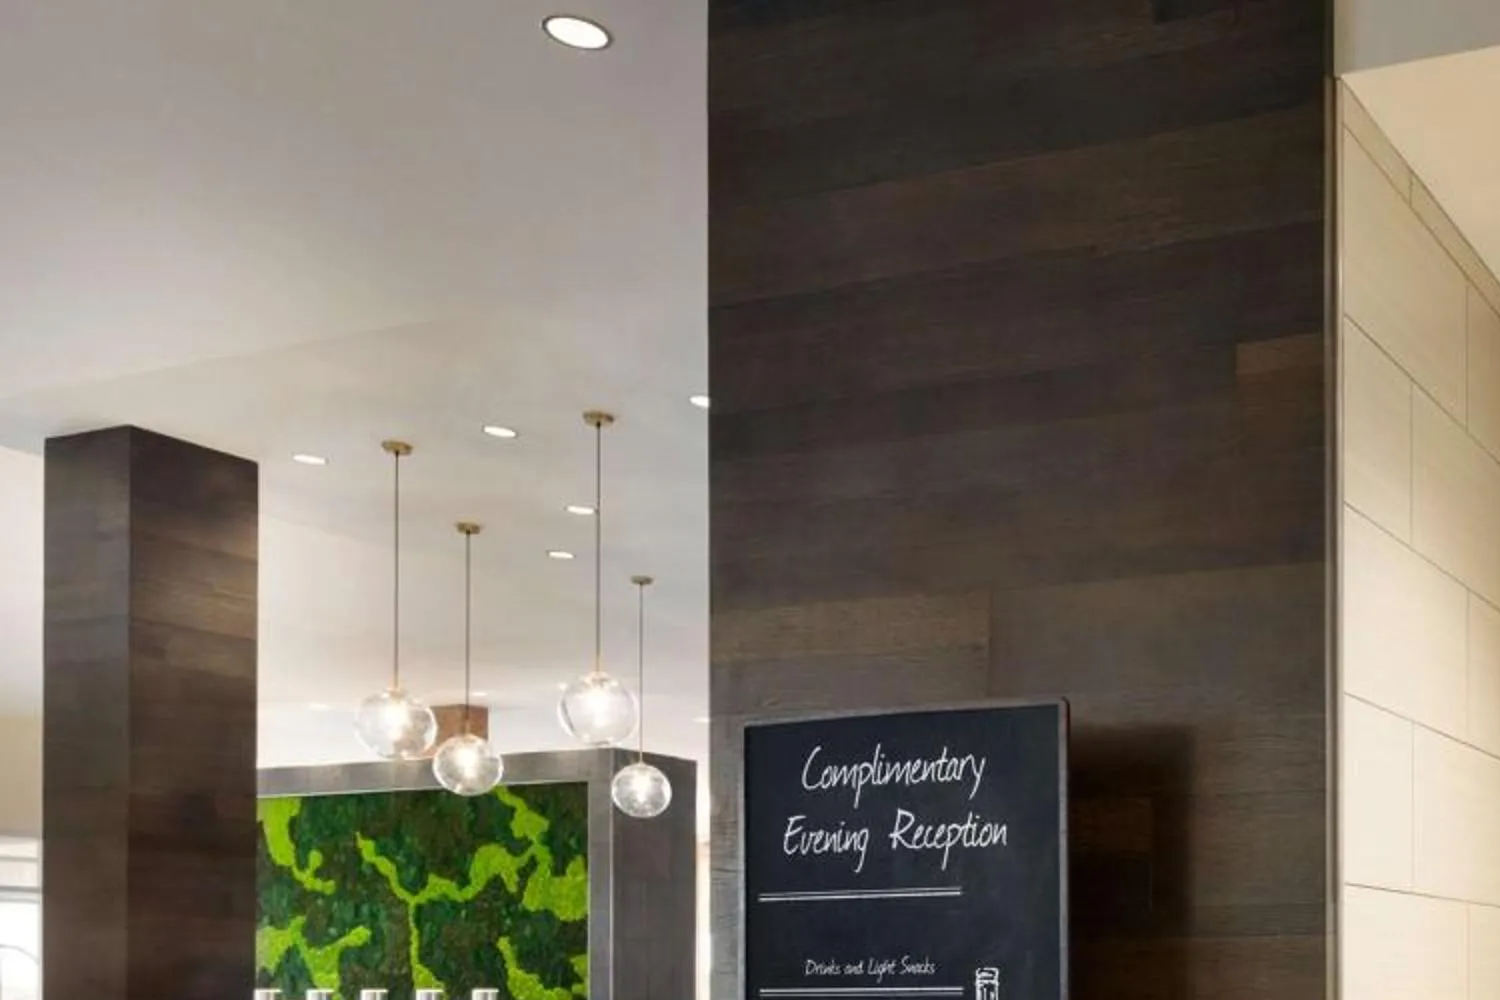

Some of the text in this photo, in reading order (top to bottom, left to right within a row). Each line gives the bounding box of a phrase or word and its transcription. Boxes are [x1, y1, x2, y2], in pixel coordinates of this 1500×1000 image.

[801, 743, 986, 808] Complimentary
[783, 808, 1008, 872] Evening Reception
[805, 954, 936, 984] Drinks and Light Snacks
